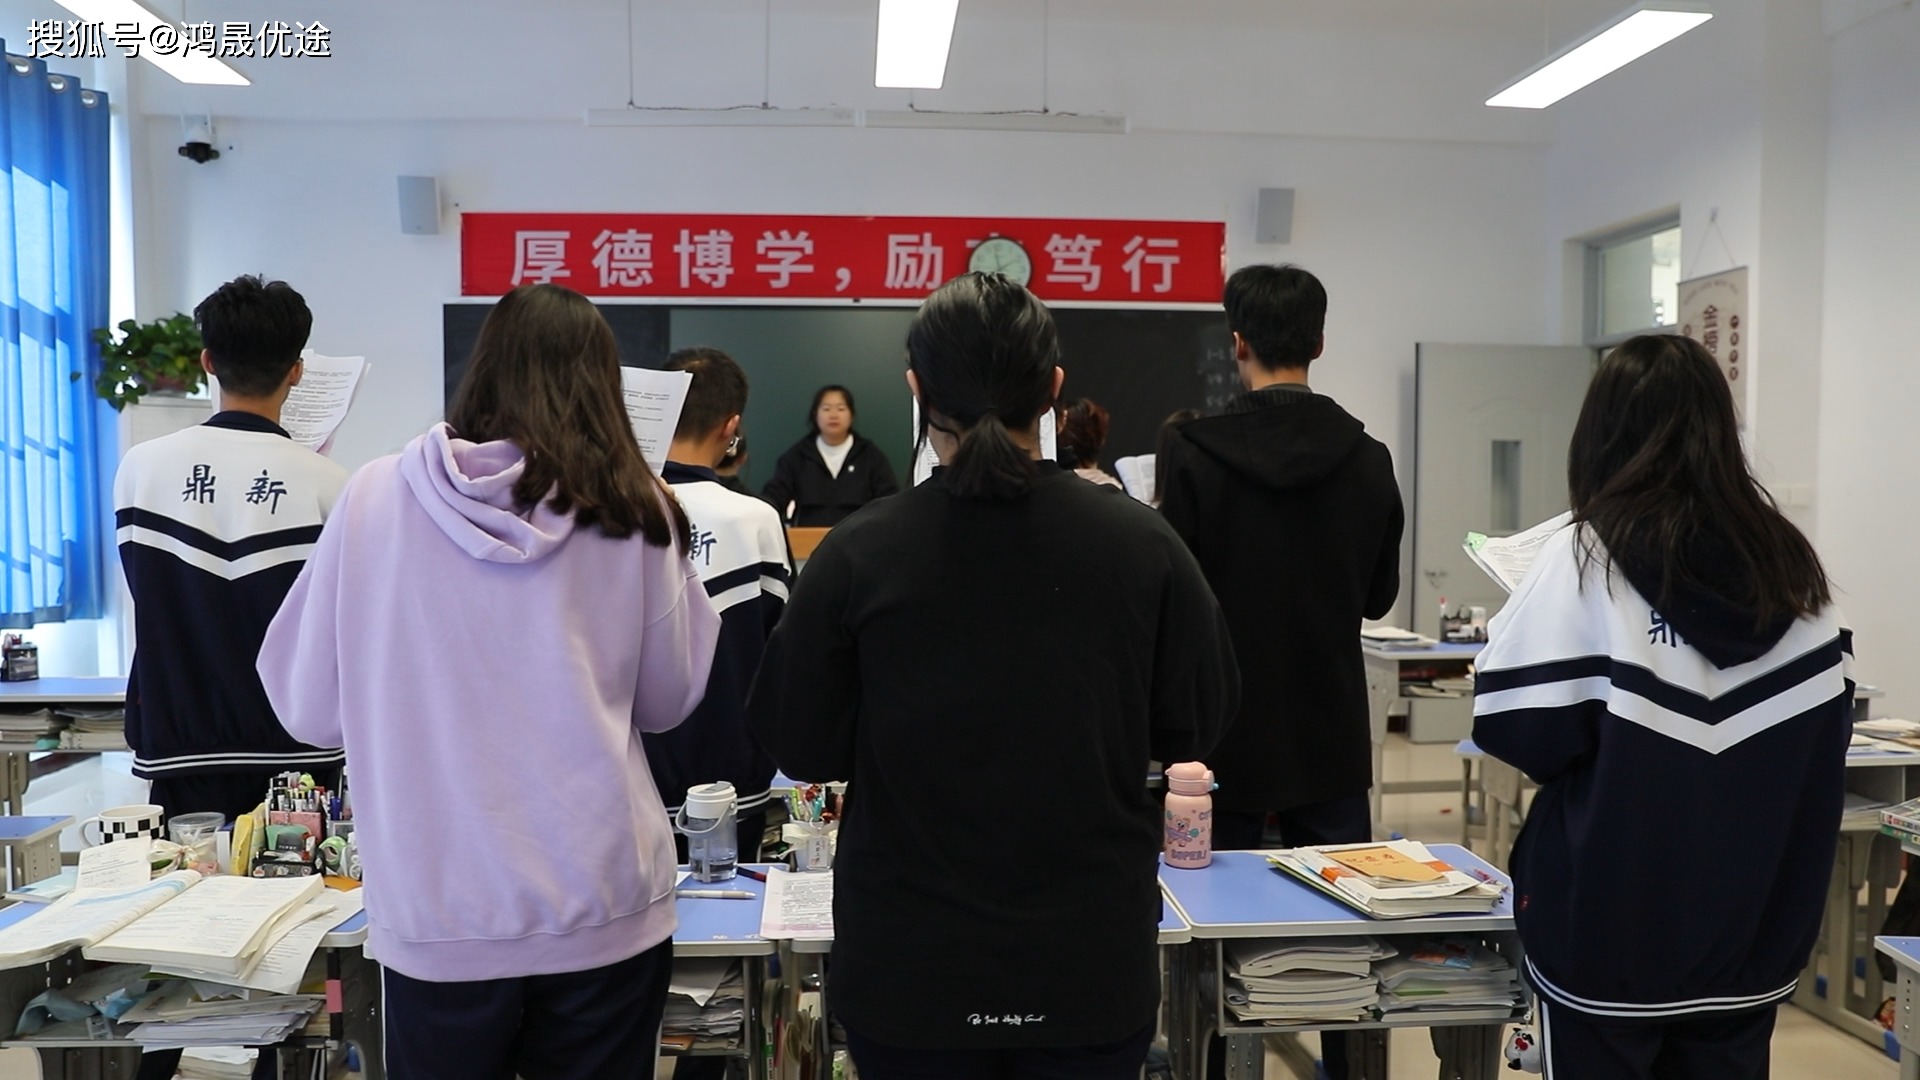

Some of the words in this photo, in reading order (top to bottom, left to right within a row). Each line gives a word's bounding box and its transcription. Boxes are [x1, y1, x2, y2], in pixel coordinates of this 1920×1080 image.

[511, 229, 1180, 293] 厚德博学，励笃行
[182, 464, 288, 515] 鼎新
